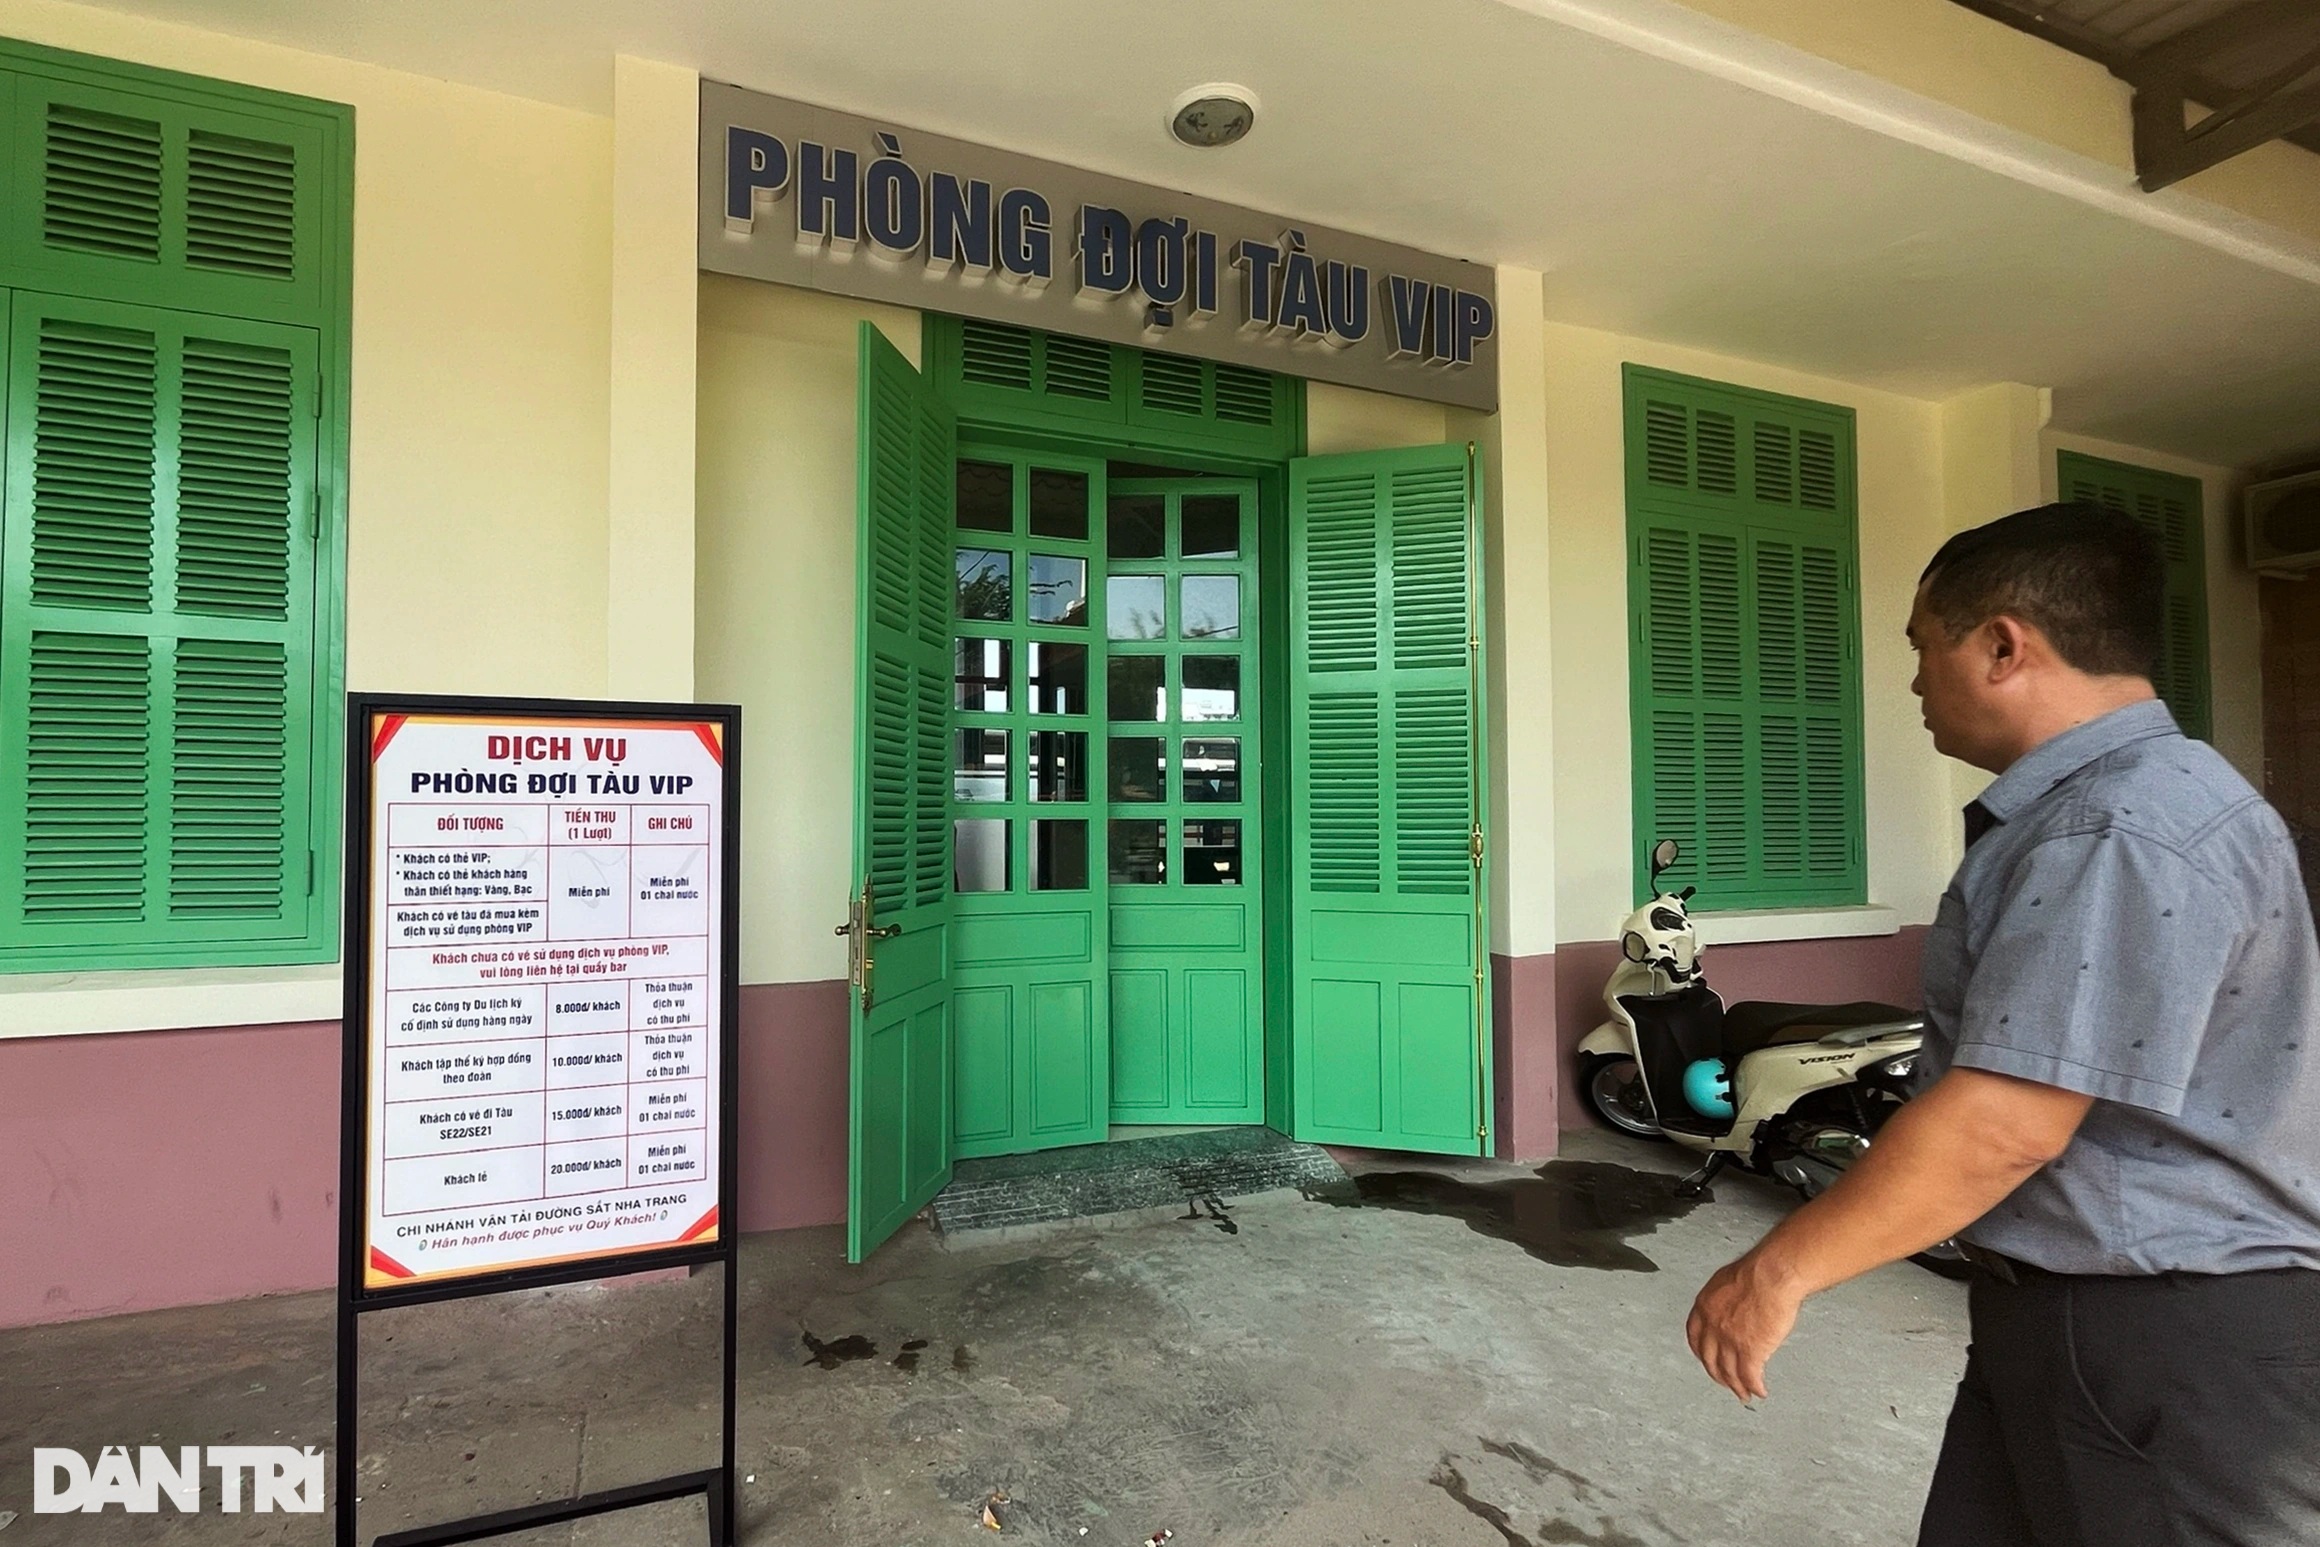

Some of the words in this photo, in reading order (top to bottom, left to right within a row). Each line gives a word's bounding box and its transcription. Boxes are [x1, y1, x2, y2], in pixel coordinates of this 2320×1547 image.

[723, 125, 1053, 280] PHÒNG
[1078, 203, 1219, 329] ĐỢI
[1240, 231, 1370, 344] TÀU
[1390, 273, 1495, 366] VIP
[488, 736, 571, 764] DỊCH
[584, 738, 626, 766] VỤ
[412, 768, 517, 794] PHÒNG
[528, 772, 576, 798] ĐỢI
[586, 771, 640, 794] TÀU
[649, 776, 693, 794] VIP
[594, 811, 616, 823] THU
[648, 818, 667, 830] GHI
[670, 816, 692, 830] CHÚ
[438, 814, 458, 830] ĐỐI
[463, 817, 504, 834] TƯỢNG
[568, 828, 579, 840] (1
[584, 828, 612, 841] Lượt)
[403, 853, 435, 864] Khách
[438, 853, 450, 863] có
[453, 852, 468, 863] thẻ
[471, 853, 491, 864] VIP;
[403, 870, 435, 880] Khách
[438, 870, 450, 880] có
[453, 869, 468, 879] thẻ
[471, 869, 501, 879] khách
[504, 869, 528, 879] hàng
[404, 886, 426, 896] thân
[429, 884, 452, 895] thiết
[455, 886, 482, 897] hạng:
[485, 885, 511, 895] Vàng,
[514, 885, 532, 896] Bạc
[404, 926, 425, 938] dịch
[429, 927, 440, 937] vụ
[444, 924, 455, 935] sử
[458, 925, 481, 936] dụng
[485, 924, 514, 935] phòng
[517, 923, 532, 932] VIP
[433, 953, 468, 964] Khách
[471, 952, 498, 963] chưa
[502, 951, 515, 962] có
[518, 951, 530, 961] vé
[533, 948, 547, 960] sử
[550, 949, 575, 961] dụng
[578, 948, 600, 960] dịch
[604, 948, 615, 959] vụ
[618, 946, 649, 957] phòng
[652, 944, 669, 956] VIP,
[480, 967, 496, 978] vui
[500, 967, 523, 978] lòng
[527, 965, 547, 976] liên
[550, 964, 563, 976] hệ
[567, 963, 579, 975] tại
[611, 963, 627, 972] bar
[413, 1002, 431, 1013] Các
[435, 1001, 460, 1013] Công
[463, 1001, 471, 1011] ty
[474, 999, 487, 1009] Du
[490, 998, 508, 1010] lịch
[511, 997, 522, 1008] ký
[653, 999, 672, 1010] dịch
[675, 999, 685, 1009] vụ
[401, 1019, 414, 1031] cố
[417, 1020, 438, 1032] định
[442, 1017, 453, 1029] sử
[456, 1018, 480, 1030] dụng
[483, 1016, 506, 1026] hàng
[509, 1014, 532, 1025] ngày
[647, 1015, 658, 1025] có
[660, 1014, 674, 1023] thu
[677, 1014, 690, 1024] phí
[653, 1051, 672, 1061] dịch
[674, 1051, 684, 1060] vụ
[1798, 1053, 1855, 1064] VISION
[647, 1067, 657, 1077] có
[660, 1066, 674, 1076] thu
[676, 1065, 690, 1076] phí
[443, 1074, 465, 1084] theo
[467, 1072, 491, 1082] đoàn
[440, 1126, 492, 1139] SE22/SE21
[396, 1226, 420, 1238] CHI
[426, 1218, 474, 1234] NHÁNH
[479, 1214, 506, 1228] VẬN
[510, 1210, 531, 1224] TẢI
[536, 1206, 582, 1221] ĐƯỜNG
[587, 1201, 611, 1215] SẮT
[615, 1199, 641, 1211] NHA
[645, 1194, 687, 1207] TRANG
[432, 1239, 458, 1249] Hân
[462, 1233, 494, 1246] hạnh
[498, 1229, 530, 1241] được
[533, 1226, 564, 1239] phục
[569, 1223, 583, 1234] vụ
[587, 1218, 611, 1230] Quý
[614, 1213, 656, 1226] Khách!
